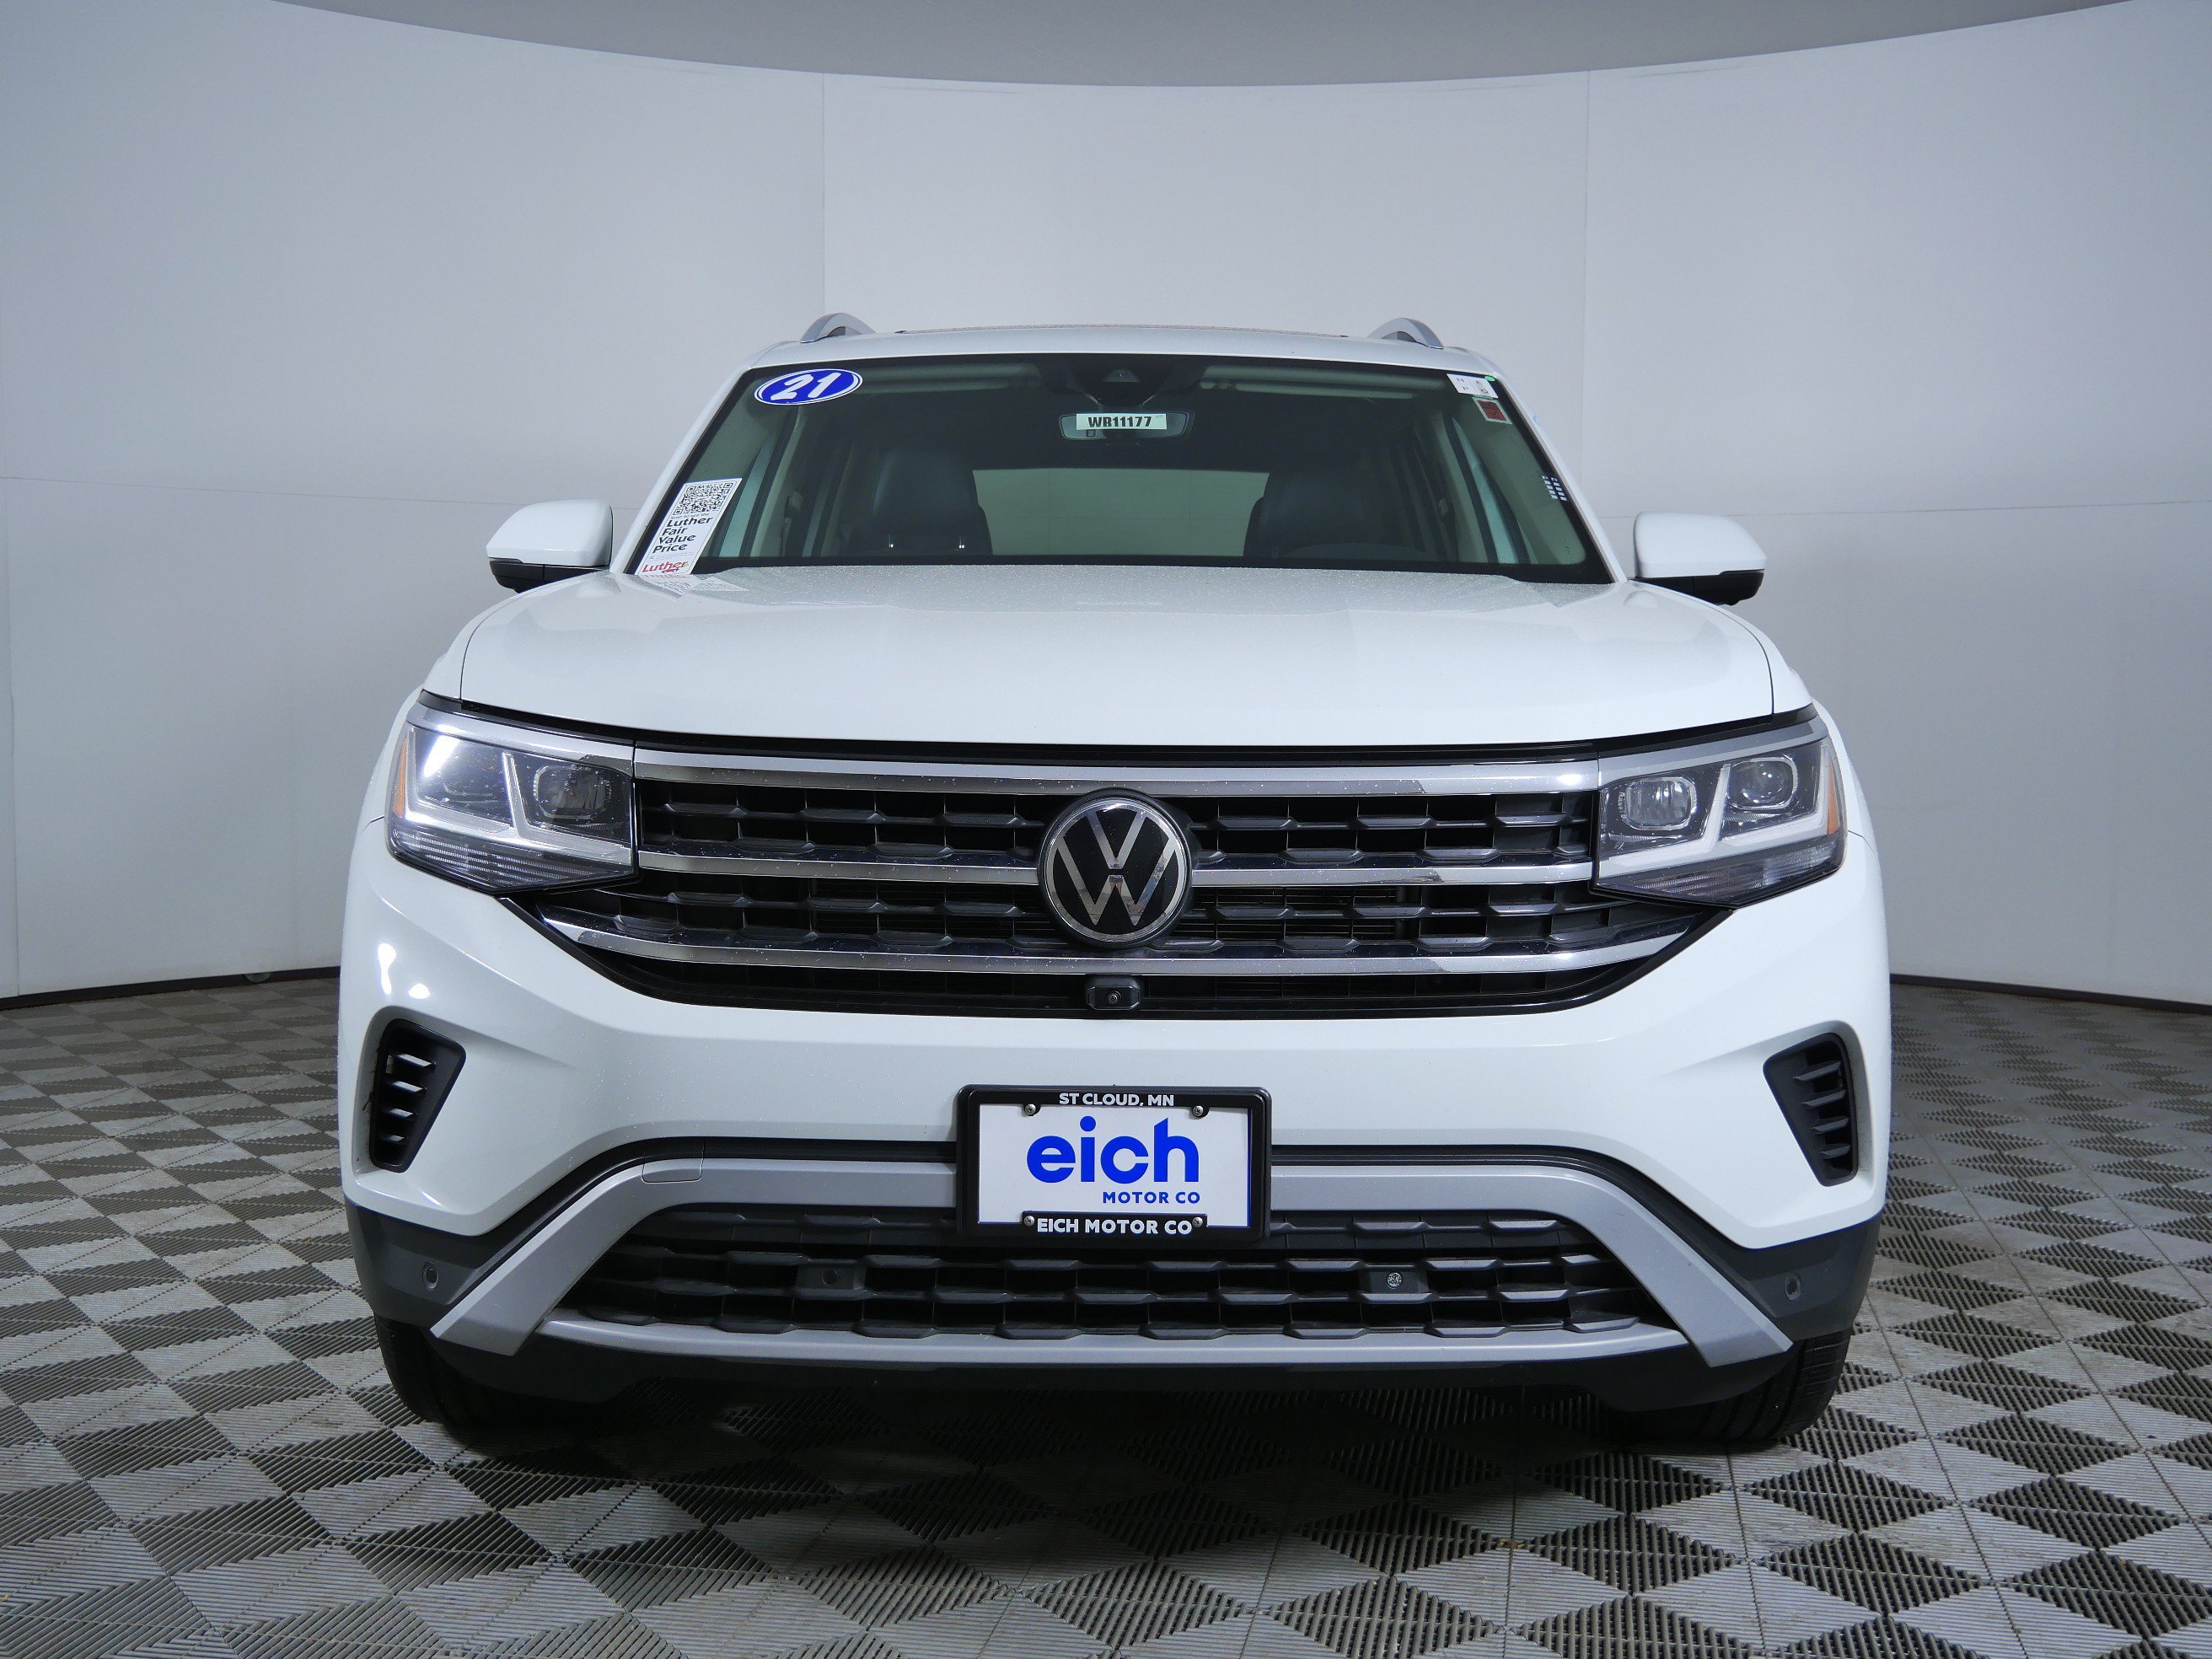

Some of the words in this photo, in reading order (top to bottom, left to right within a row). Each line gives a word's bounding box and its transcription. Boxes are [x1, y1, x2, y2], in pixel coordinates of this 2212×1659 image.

[770, 372, 841, 400] 21
[1087, 416, 1152, 428] WR11177
[666, 517, 713, 528] Luther
[662, 526, 688, 536] Fair
[658, 534, 696, 545] Value
[652, 544, 688, 554] Price
[642, 561, 689, 572] Luther
[1059, 1093, 1080, 1106] ST
[1082, 1093, 1144, 1107] CLOUD,
[1148, 1093, 1174, 1107] MN
[1027, 1115, 1200, 1184] eich
[1103, 1191, 1169, 1204] MOTOR
[1176, 1191, 1200, 1204] CO
[1037, 1218, 1079, 1233] EICH
[1085, 1219, 1158, 1234] MOTOR
[1165, 1220, 1193, 1235] CO
